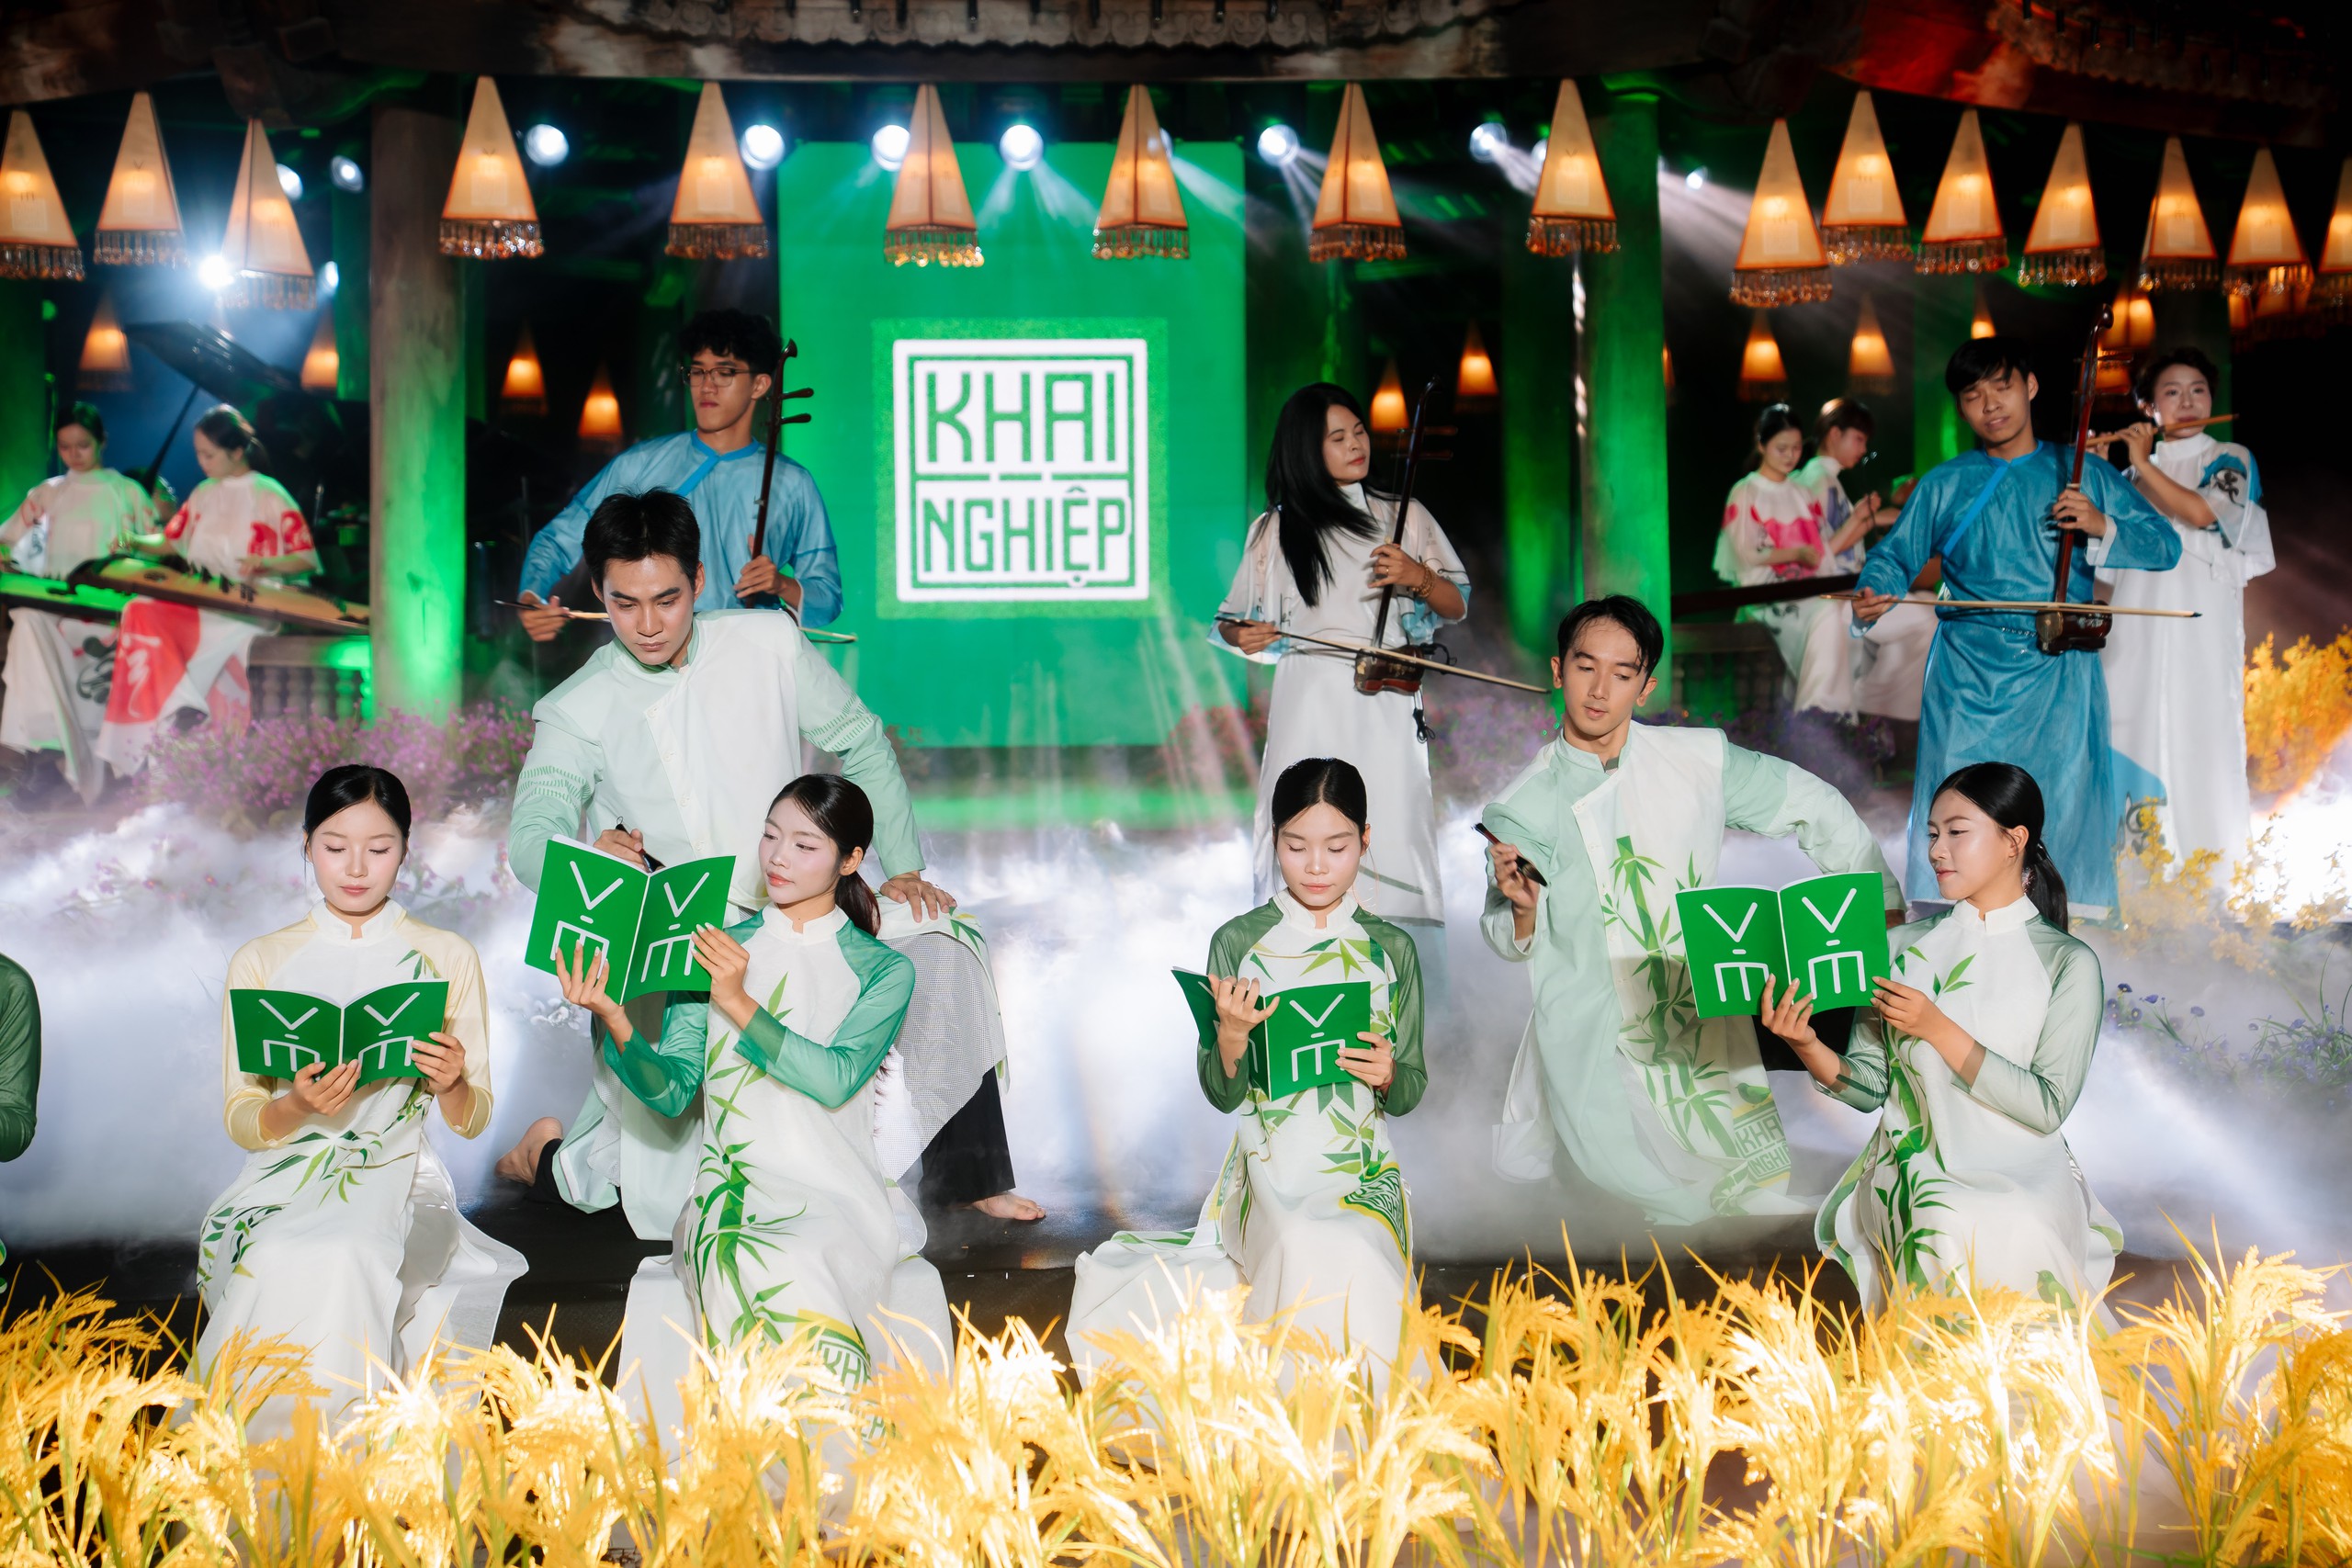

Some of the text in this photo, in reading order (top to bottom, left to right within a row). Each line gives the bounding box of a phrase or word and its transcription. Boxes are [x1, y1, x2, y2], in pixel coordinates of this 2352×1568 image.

[926, 371, 1116, 462] KHAI
[922, 485, 1126, 583] NGHIỆP
[1735, 1114, 1786, 1154] KHA
[1748, 1144, 1792, 1175] NGHI
